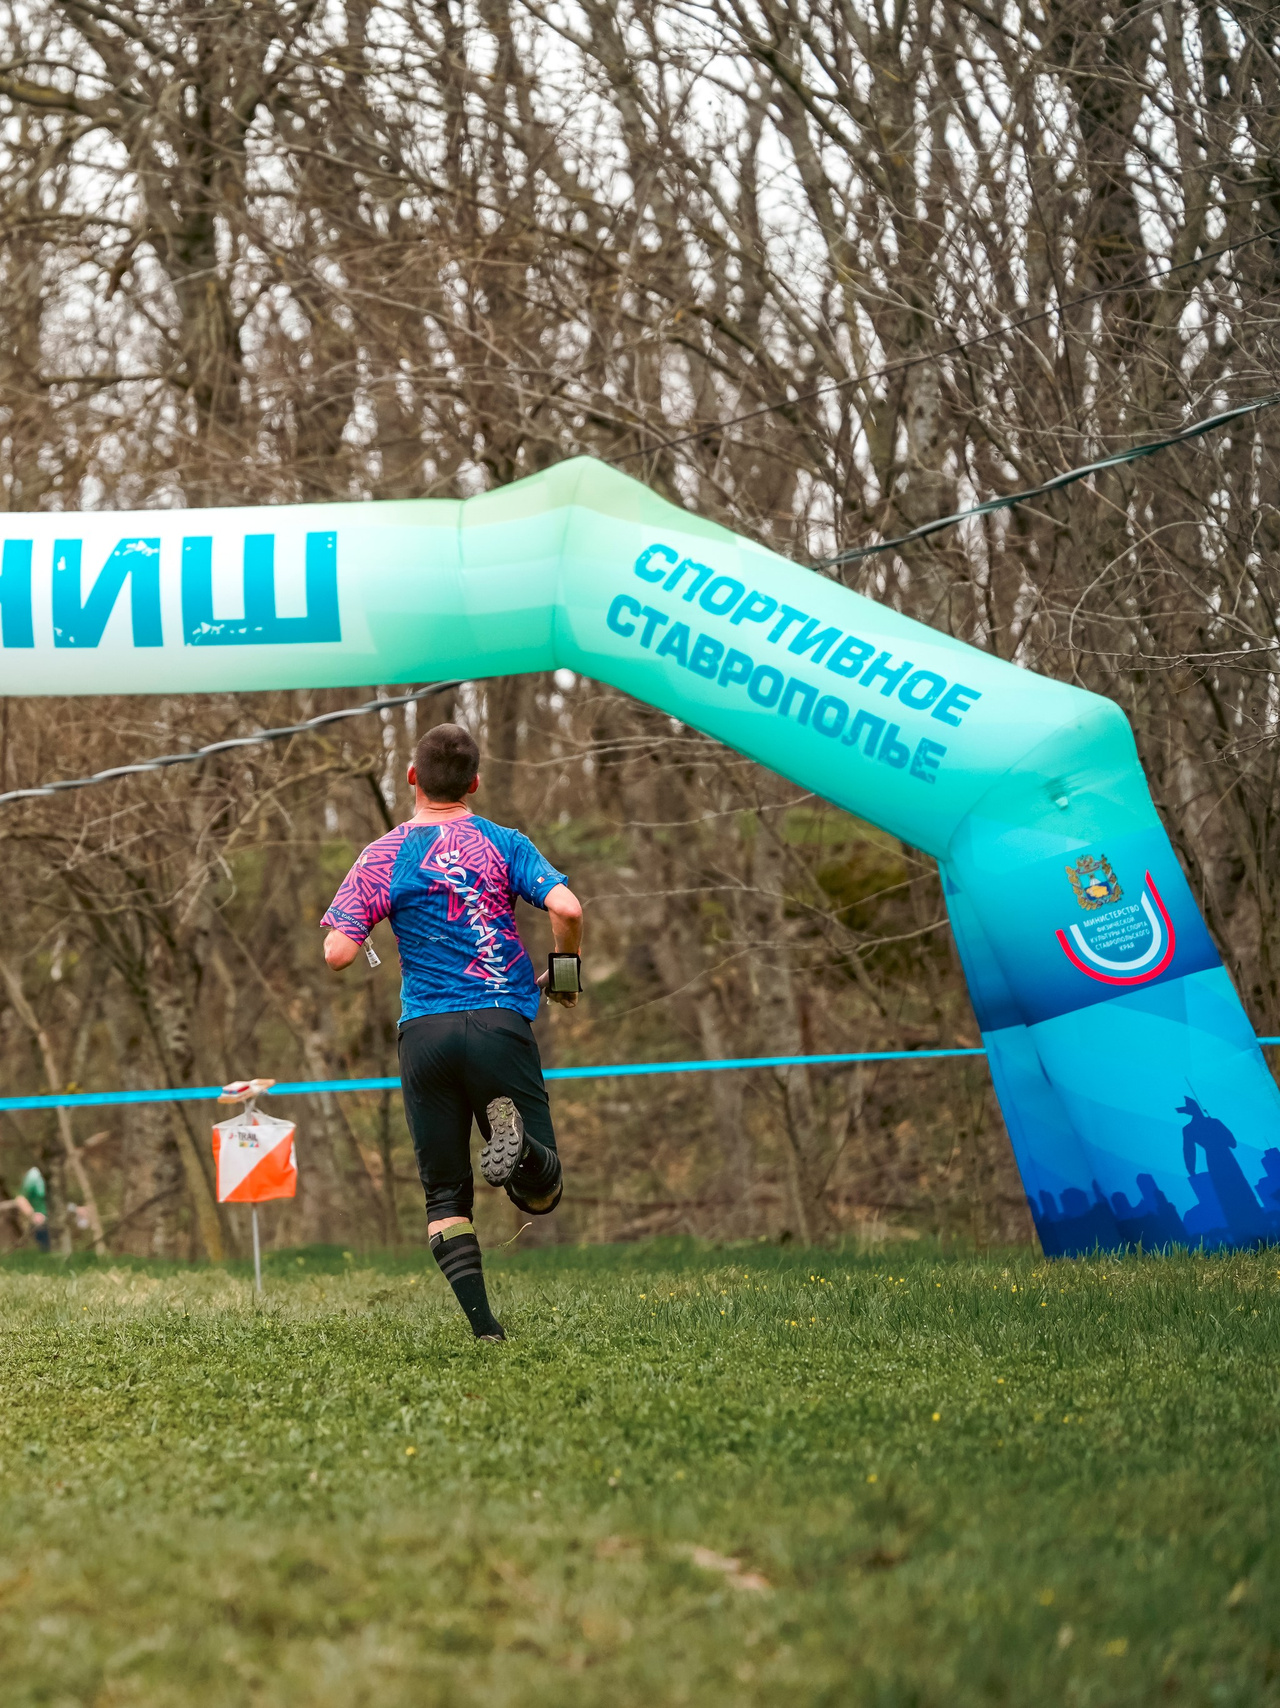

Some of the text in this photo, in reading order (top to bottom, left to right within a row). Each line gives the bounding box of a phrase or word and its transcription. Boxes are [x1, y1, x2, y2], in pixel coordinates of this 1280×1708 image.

[633, 543, 982, 727] СПОРТИВНОЕ
[606, 594, 947, 784] СТАВРОПОЛЬЕ
[1083, 904, 1140, 928] МИНИСТЕРСТВО
[1097, 915, 1135, 933] ФИЗИЧЕСКОЙ
[1090, 930, 1120, 944] КУЛЬТУРЫ
[1126, 921, 1148, 932] СПОРТА
[1095, 929, 1150, 951] СТАВРОПОЛЬСКОГО
[1119, 942, 1135, 951] КРАЯ
